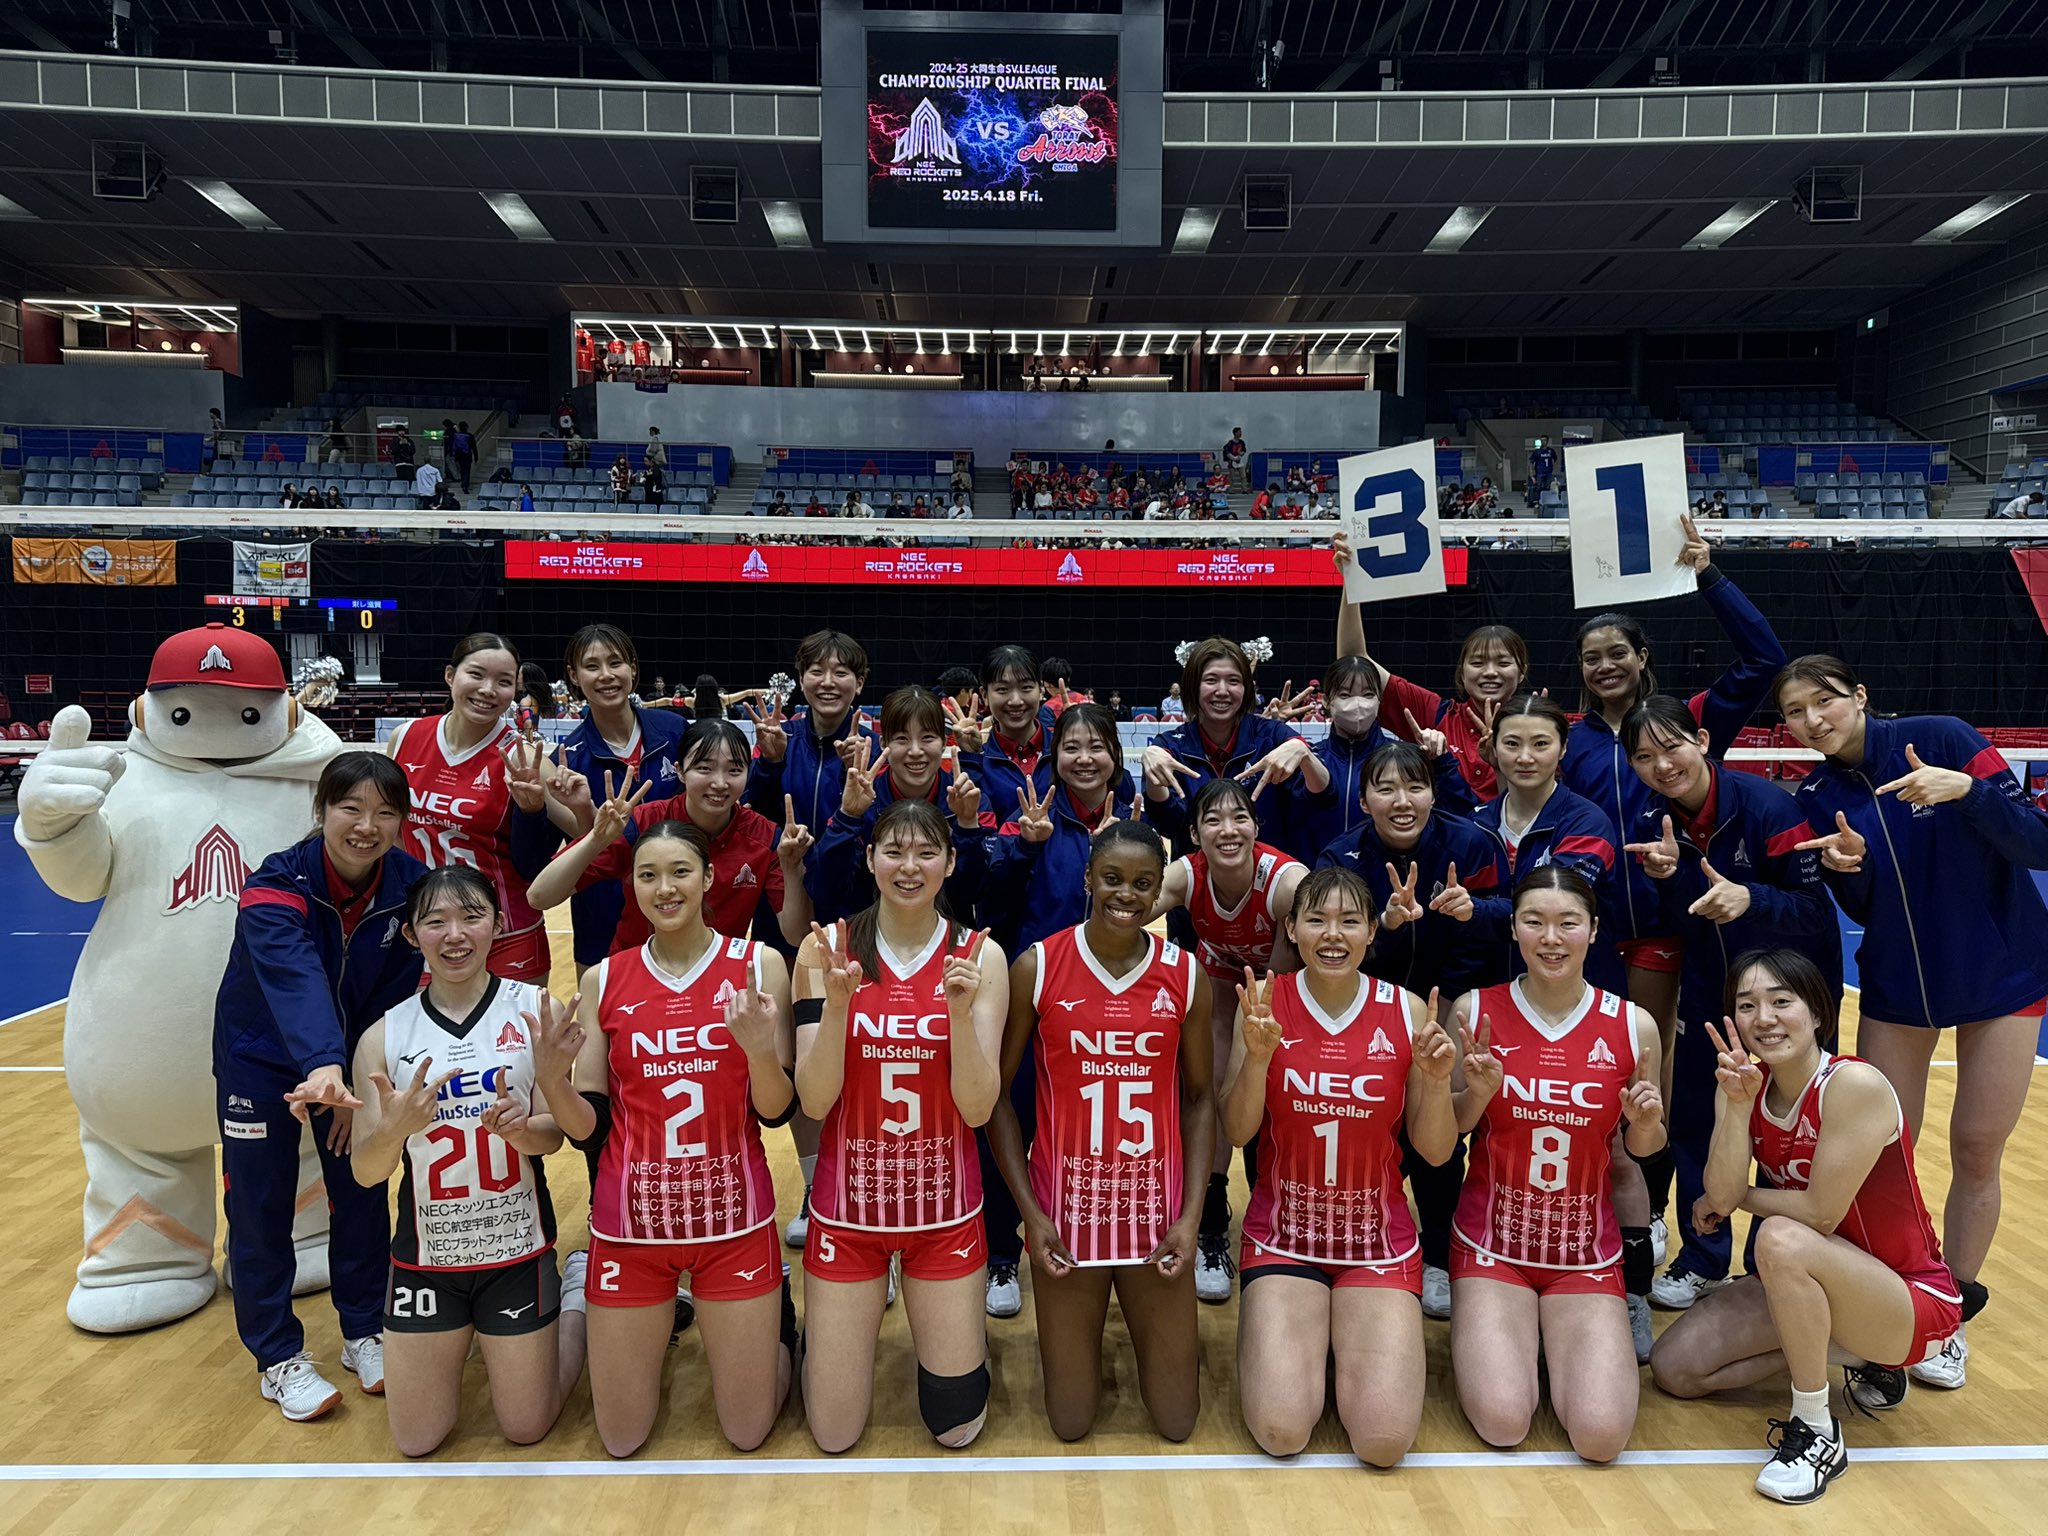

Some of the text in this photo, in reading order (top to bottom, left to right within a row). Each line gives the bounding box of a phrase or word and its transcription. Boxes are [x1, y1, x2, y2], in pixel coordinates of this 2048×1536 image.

[929, 63, 968, 74] 2024-25
[879, 74, 1107, 92] CHAMPIONSHIP QUARTER FINAL
[976, 121, 1010, 140] VS
[1052, 130, 1081, 141] TORAY
[1018, 133, 1107, 163] Arrows
[889, 168, 962, 177] RED ROCKETS
[942, 190, 1043, 202] 2025.4.18 Fri.
[1354, 467, 1430, 579] 3
[1595, 462, 1651, 576] 1
[248, 550, 297, 561] スポーツくじ
[539, 556, 643, 568] RED ROCKETS
[577, 547, 604, 556] NEC
[901, 552, 927, 561] NEC
[1213, 554, 1239, 563] NEC
[865, 562, 963, 573] RED ROCKETS
[1177, 563, 1275, 573] RED ROCKETS
[232, 606, 245, 627] 3
[360, 610, 373, 629] 0
[409, 787, 477, 820] NEC
[852, 1012, 948, 1041] NEC
[631, 1023, 729, 1058] NEC
[1070, 1030, 1164, 1057] NEC
[862, 1044, 937, 1060] BluStellar
[643, 1058, 719, 1078] BluStellar
[1081, 1060, 1152, 1077] BluStellar
[1283, 1068, 1385, 1102] NEC
[1502, 1074, 1603, 1109] NEC
[880, 1062, 921, 1137] 5
[1292, 1099, 1373, 1119] BluStellar
[661, 1078, 707, 1159] 2
[1079, 1080, 1154, 1158] 15
[1512, 1105, 1592, 1127] BluStellar
[846, 1135, 954, 1153] NECネッツエスアイ
[1312, 1119, 1339, 1187] 1
[425, 1123, 522, 1200] 20
[629, 1152, 741, 1176] NECネッツエスアイ
[851, 1155, 950, 1172] NEC航空宇宙システム
[1063, 1156, 1165, 1173] NECネッツエスアイ
[1528, 1125, 1572, 1193] 8
[633, 1172, 740, 1195] NEC航空宇宙システム
[849, 1171, 951, 1189] NECプラットフォームズ
[1067, 1175, 1161, 1192] NEC航空宇宙システム
[1280, 1178, 1381, 1201] NECネッツエスアイ
[419, 1189, 533, 1218] NECネッツエスアイ
[632, 1188, 742, 1212] NECプラットフォームズ
[850, 1189, 951, 1204] NECネットワーク・センサ
[1065, 1193, 1163, 1210] NECプラットフォームズ
[1285, 1195, 1378, 1215] NEC航空宇宙システム
[1495, 1182, 1597, 1208] NECネッツエスアイ
[425, 1208, 531, 1235] NEC航空宇宙システム
[634, 1206, 743, 1228] NECネットワーク・センサ
[1064, 1211, 1164, 1226] NECネットワーク・センサ
[1281, 1210, 1379, 1230] NECプラットフォームズ
[1498, 1199, 1593, 1222] NEC航空宇宙システム
[1495, 1214, 1593, 1238] NECプラットフォームズ
[427, 1225, 533, 1252] NECプラットフォームズ
[818, 1232, 836, 1263] 5
[430, 1241, 535, 1266] NECネットワーク・センサ
[600, 1260, 621, 1291] 2
[393, 1286, 438, 1318] 20
